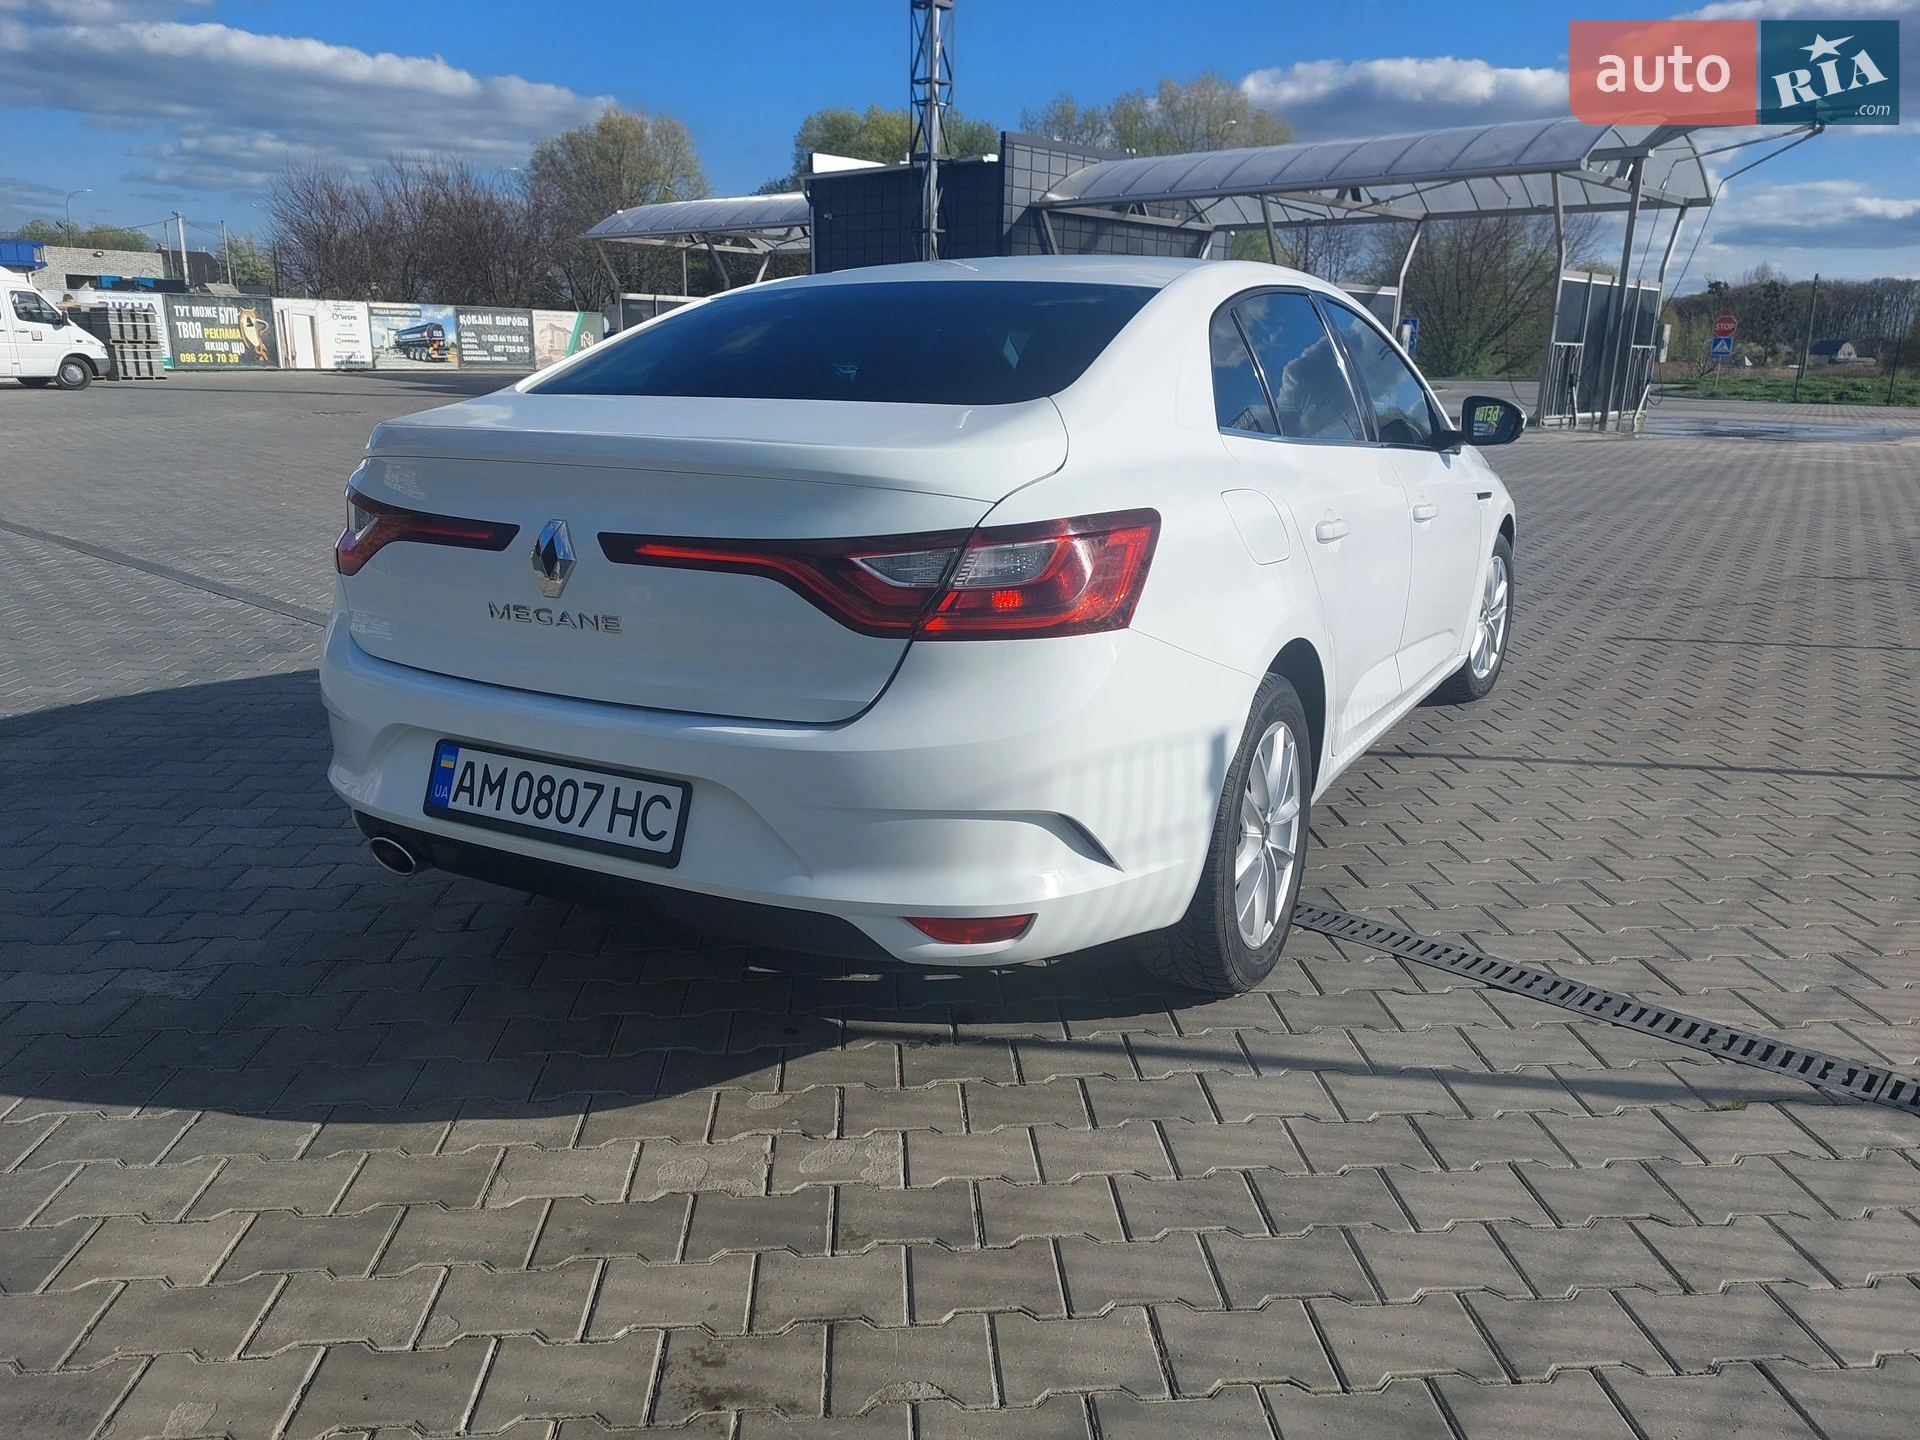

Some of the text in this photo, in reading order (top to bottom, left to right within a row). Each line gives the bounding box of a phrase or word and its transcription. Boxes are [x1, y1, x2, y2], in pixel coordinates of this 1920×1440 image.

[173, 305, 190, 317] ТУТ
[192, 306, 218, 318] МОЖЕ
[459, 313, 493, 326] КОВАНІ
[495, 316, 529, 327] ВИРОБИ
[1714, 322, 1736, 331] STOP
[175, 321, 242, 339] ТВОЯ РЕКЛАМА
[204, 341, 246, 355] ЯКЩО ЩО
[180, 353, 239, 363] 096 221 70 39
[488, 601, 623, 634] MEGANE
[434, 784, 448, 800] UA
